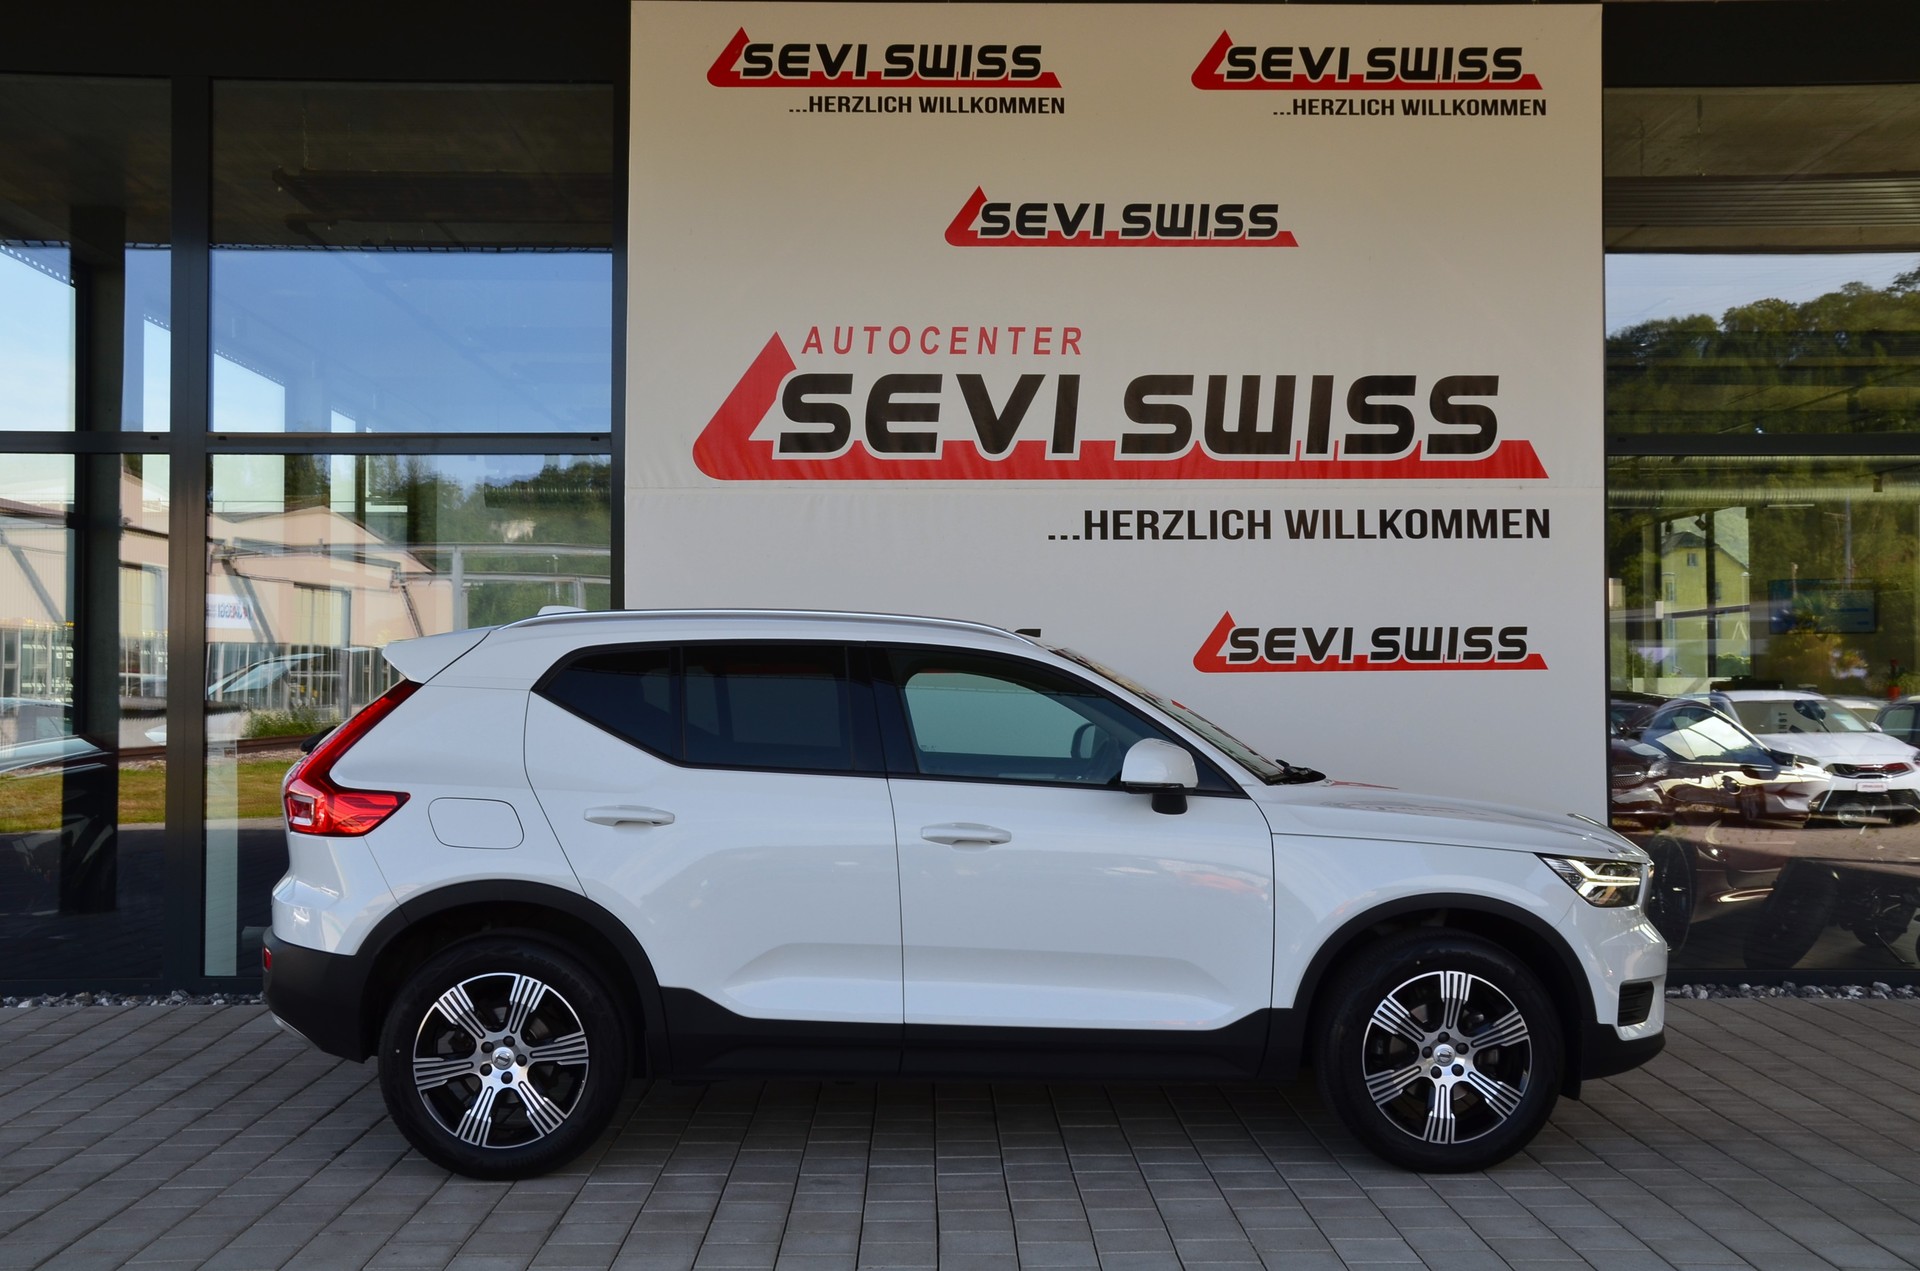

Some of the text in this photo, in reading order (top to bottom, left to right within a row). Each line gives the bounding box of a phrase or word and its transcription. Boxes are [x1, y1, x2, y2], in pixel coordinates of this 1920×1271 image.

[742, 43, 1042, 78] SEVI SWISS
[1226, 46, 1523, 81] SEVI SWISS
[918, 96, 1065, 114] WILLKOMMEN
[1401, 99, 1546, 117] WILLKOMMEN
[980, 202, 1279, 237] SEVI SWISS
[802, 326, 1083, 355] AUTOCENTER
[778, 373, 1499, 455] SEVI SWISS
[1284, 508, 1550, 540] WILLKOMMEN
[1229, 626, 1528, 662] SEVI SWISS
